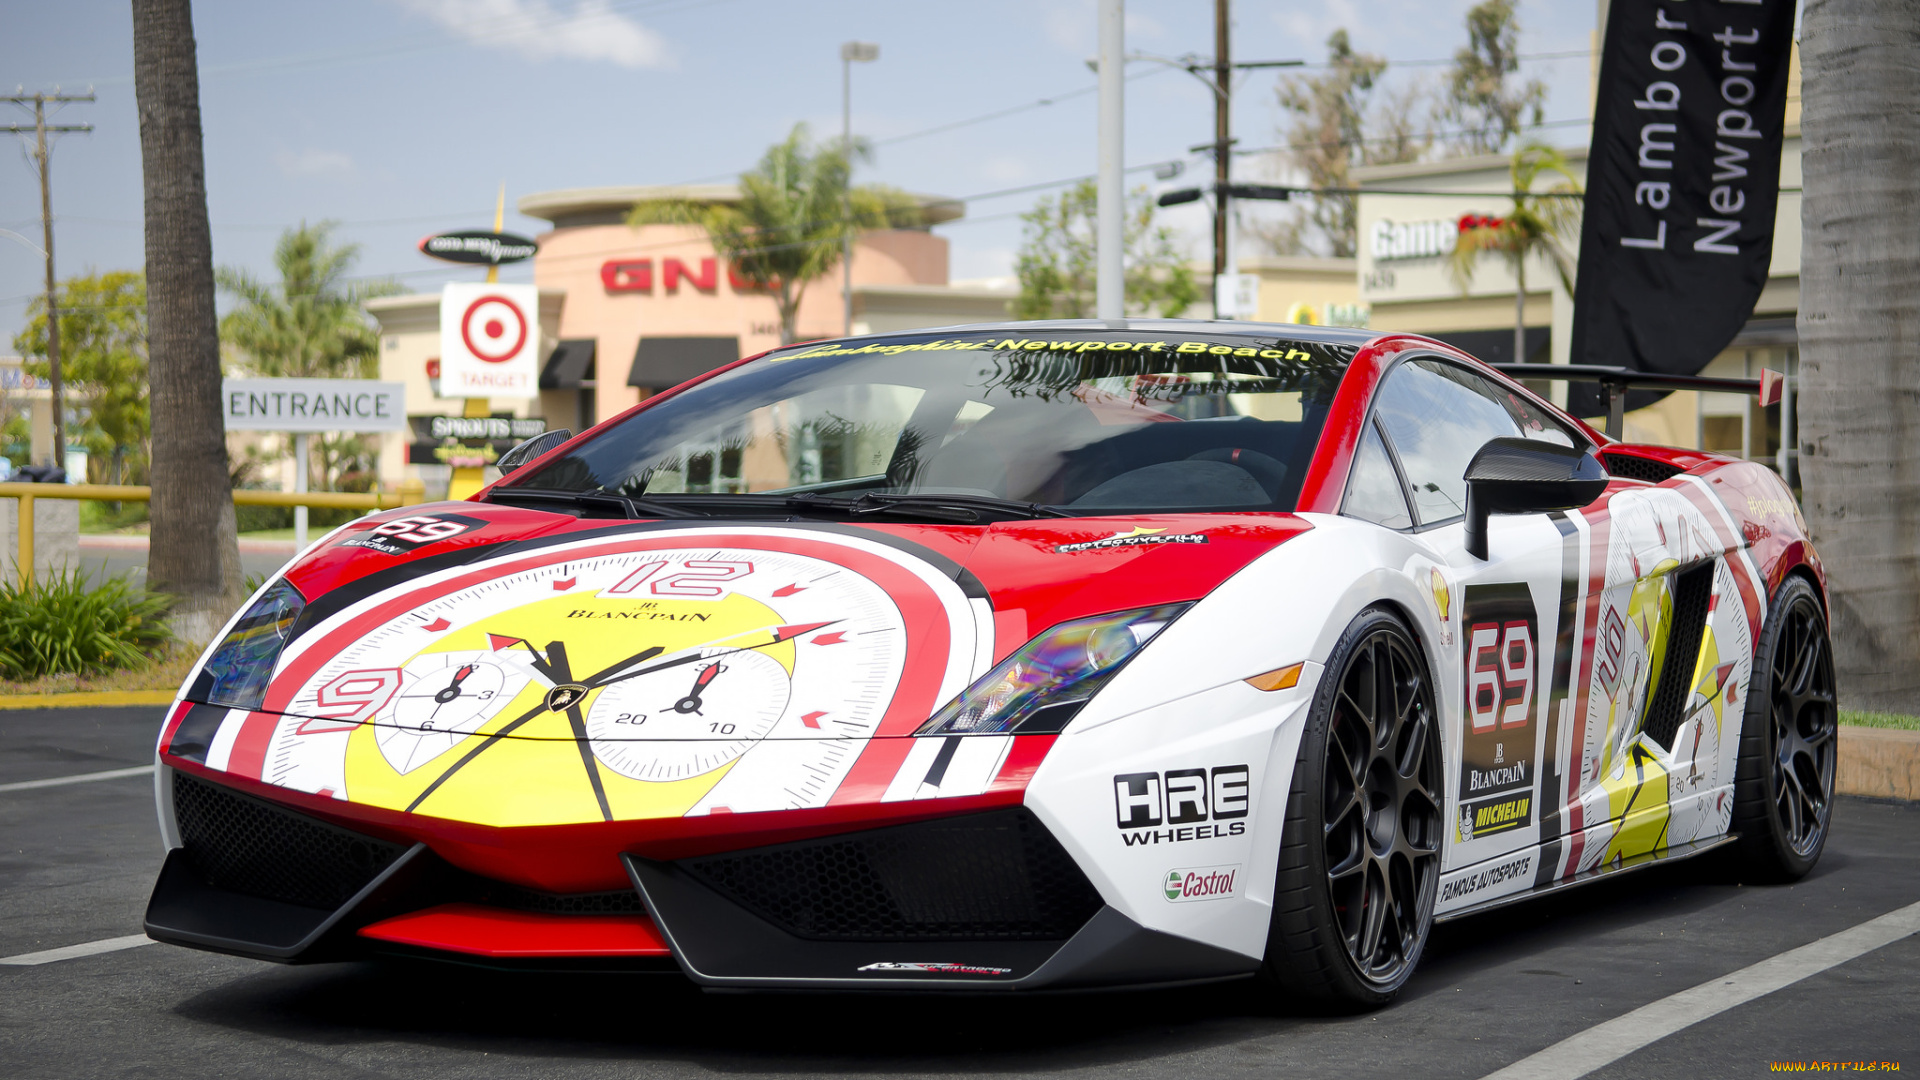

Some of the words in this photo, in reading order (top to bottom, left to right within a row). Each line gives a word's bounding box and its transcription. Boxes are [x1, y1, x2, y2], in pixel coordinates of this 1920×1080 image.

[1620, 0, 1687, 250] Lambor
[1694, 26, 1763, 254] Newport
[770, 339, 995, 362] Lamborghini
[993, 339, 1167, 353] Newport
[1177, 341, 1311, 361] Beach
[462, 372, 528, 387] TARGET
[230, 392, 390, 417] ENTRANCE
[432, 417, 510, 439] SPROUTS
[370, 516, 469, 543] 69
[1059, 536, 1162, 551] PROTECTIVE
[1165, 534, 1204, 544] FILM
[608, 561, 754, 596] 12
[566, 610, 712, 622] BLANCPAIN
[1467, 620, 1535, 734] 69
[479, 690, 494, 700] 3
[420, 720, 436, 731] 6
[615, 713, 648, 725] 20
[709, 722, 736, 735] 10
[1470, 760, 1525, 791] BLANCPAIN
[1113, 764, 1249, 829] HRE
[1475, 798, 1530, 828] MICHELIN
[1121, 822, 1246, 846] WHEELS
[1183, 869, 1236, 898] Castrol
[1440, 874, 1478, 903] FAMOUS
[1476, 856, 1531, 891] AUTOSPORTS
